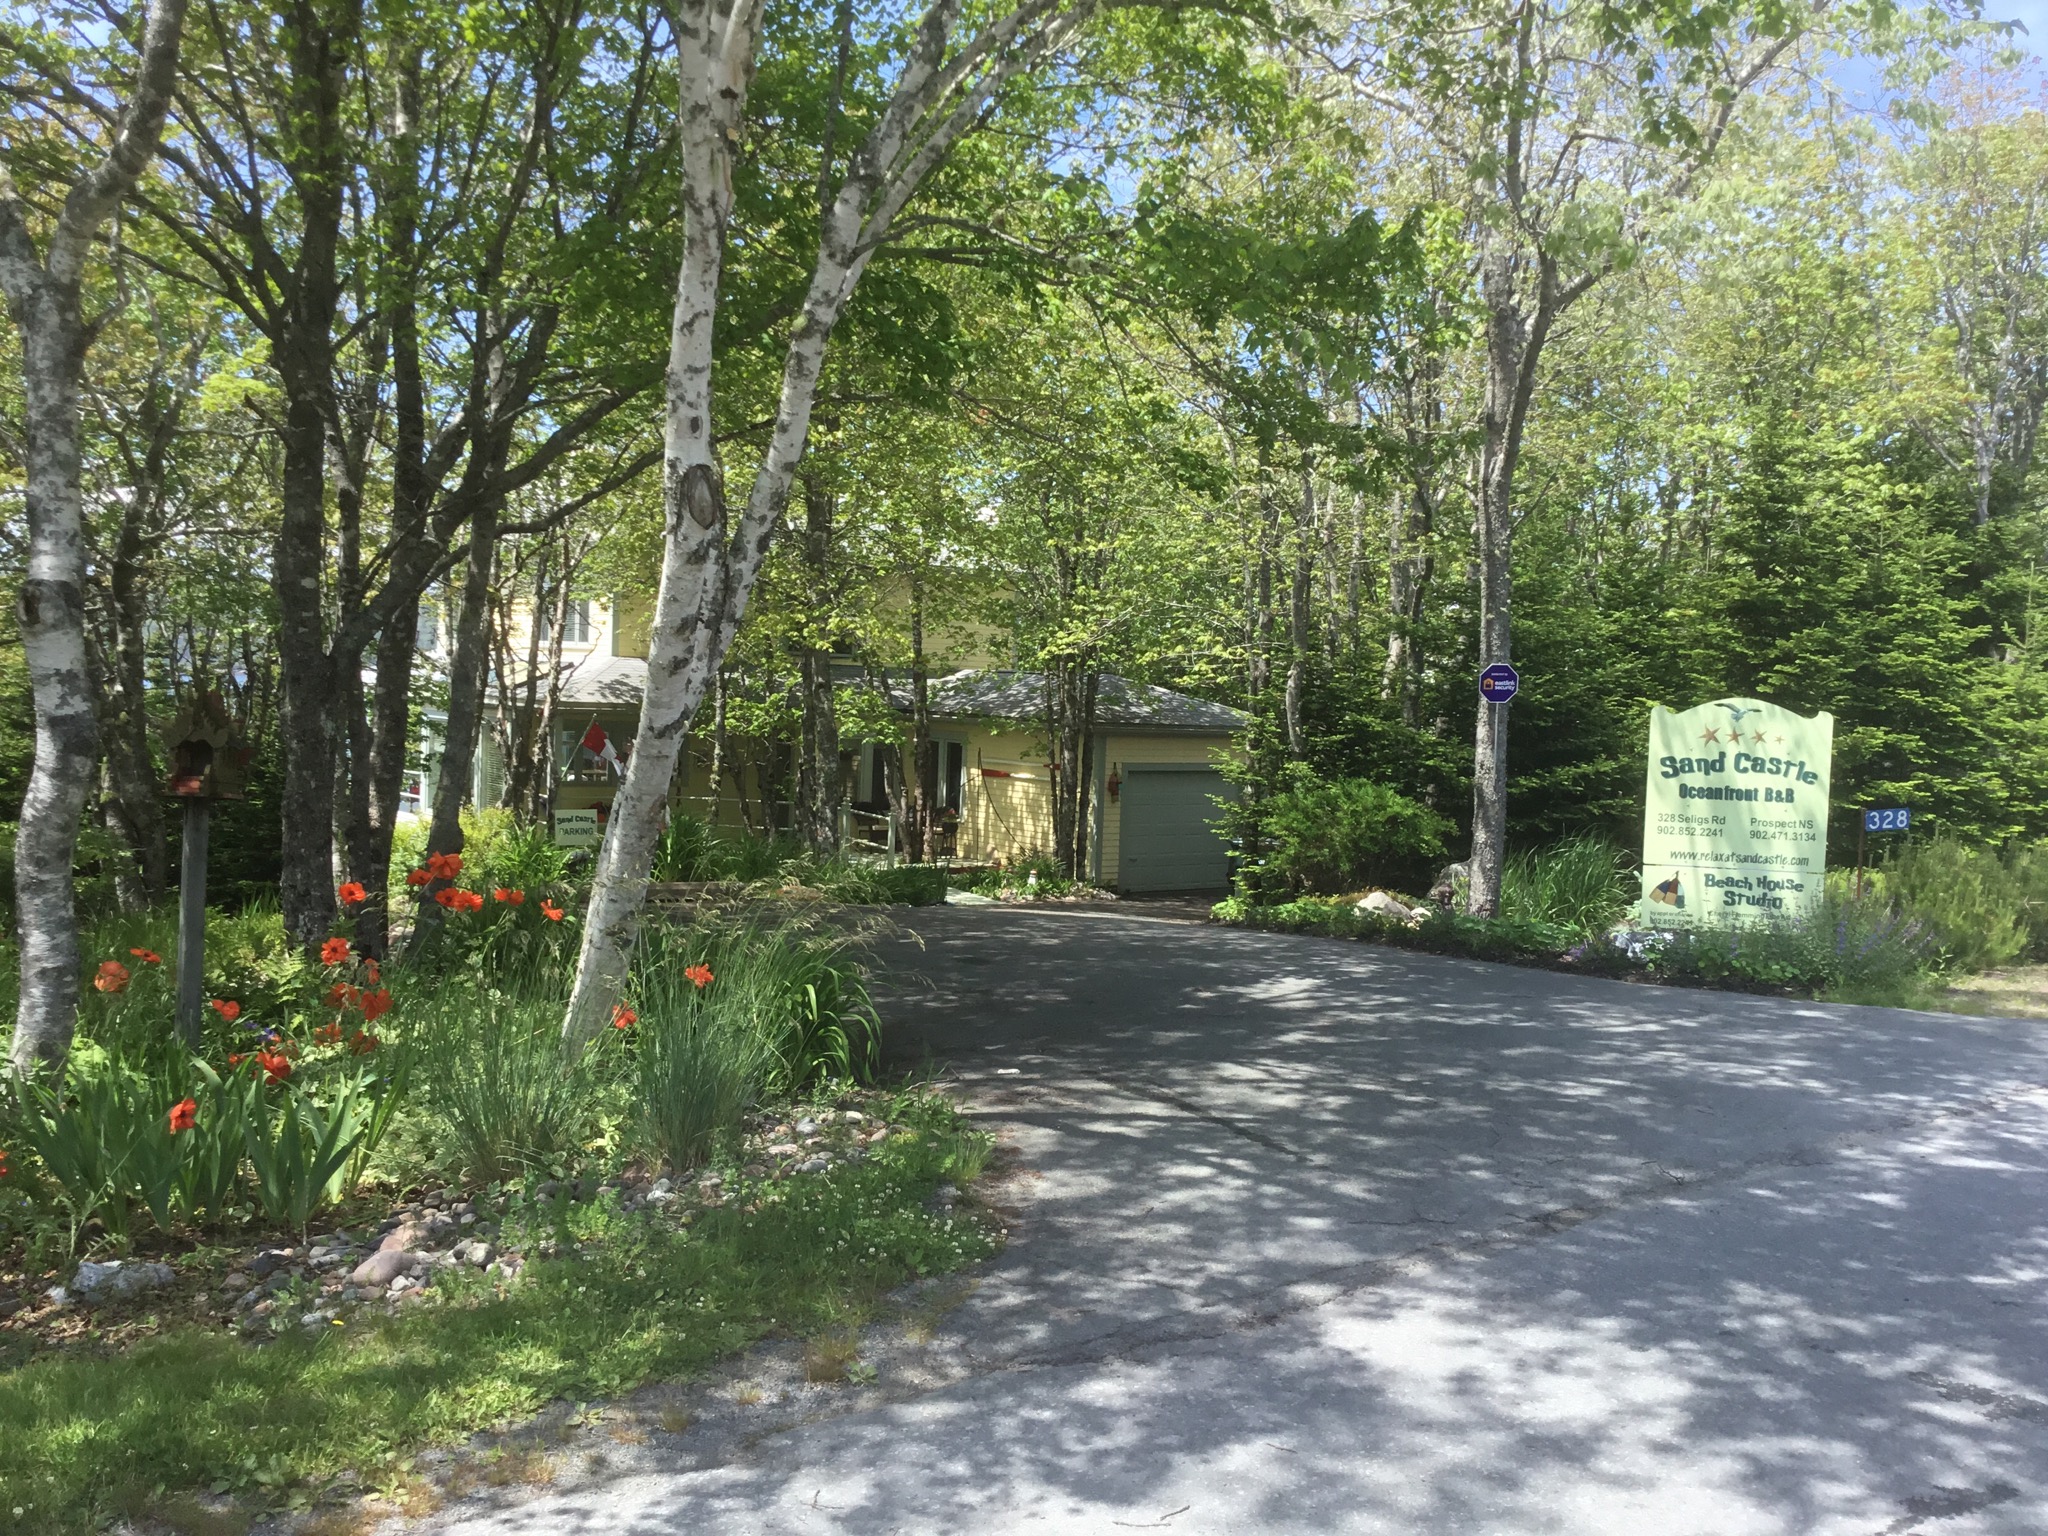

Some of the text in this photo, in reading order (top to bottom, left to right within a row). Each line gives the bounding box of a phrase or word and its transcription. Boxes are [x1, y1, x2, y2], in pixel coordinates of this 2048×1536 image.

[1660, 751, 1818, 785] Sand Castle
[1679, 783, 1795, 803] Oceanfront B&B
[556, 815, 596, 825] Sand Castle
[1657, 813, 1726, 826] 328 Seligs Rd
[1750, 818, 1814, 830] Prospect NS
[1869, 810, 1908, 830] 328
[1656, 826, 1723, 838] 902.852.2241
[1749, 830, 1816, 842] 902.471.3134
[1669, 851, 1810, 867] www.relaxatsandcastle.com
[1704, 873, 1804, 893] Beach House
[1723, 890, 1783, 910] Studio
